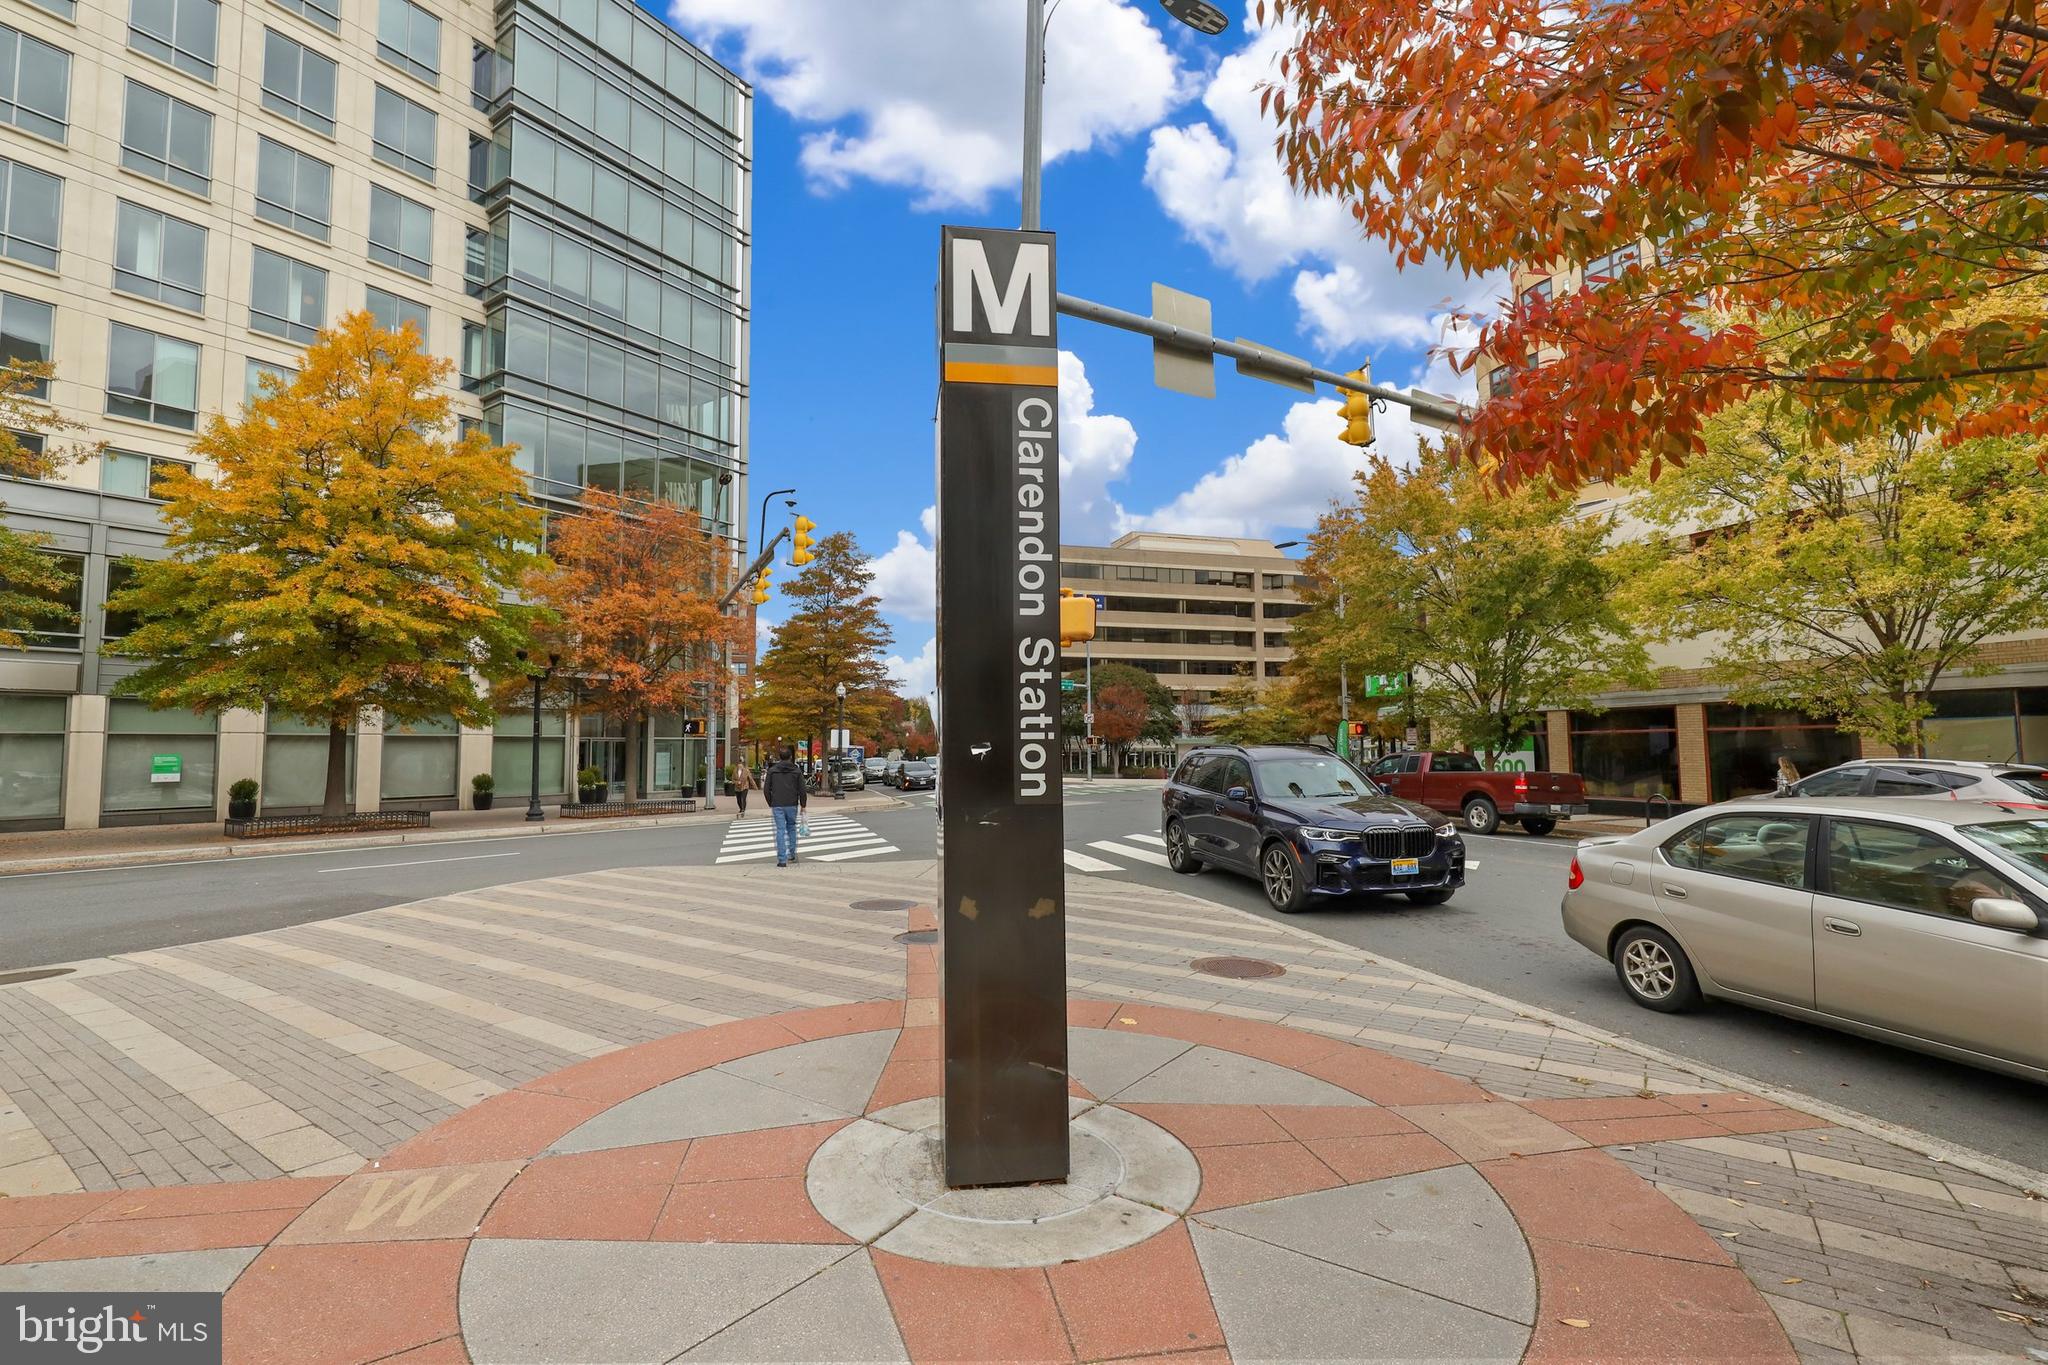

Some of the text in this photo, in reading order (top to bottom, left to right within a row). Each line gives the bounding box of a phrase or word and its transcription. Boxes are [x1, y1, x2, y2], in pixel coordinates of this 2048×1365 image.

[952, 238, 1050, 337] M
[1016, 397, 1055, 798] Clarendon Station
[345, 1172, 481, 1231] W
